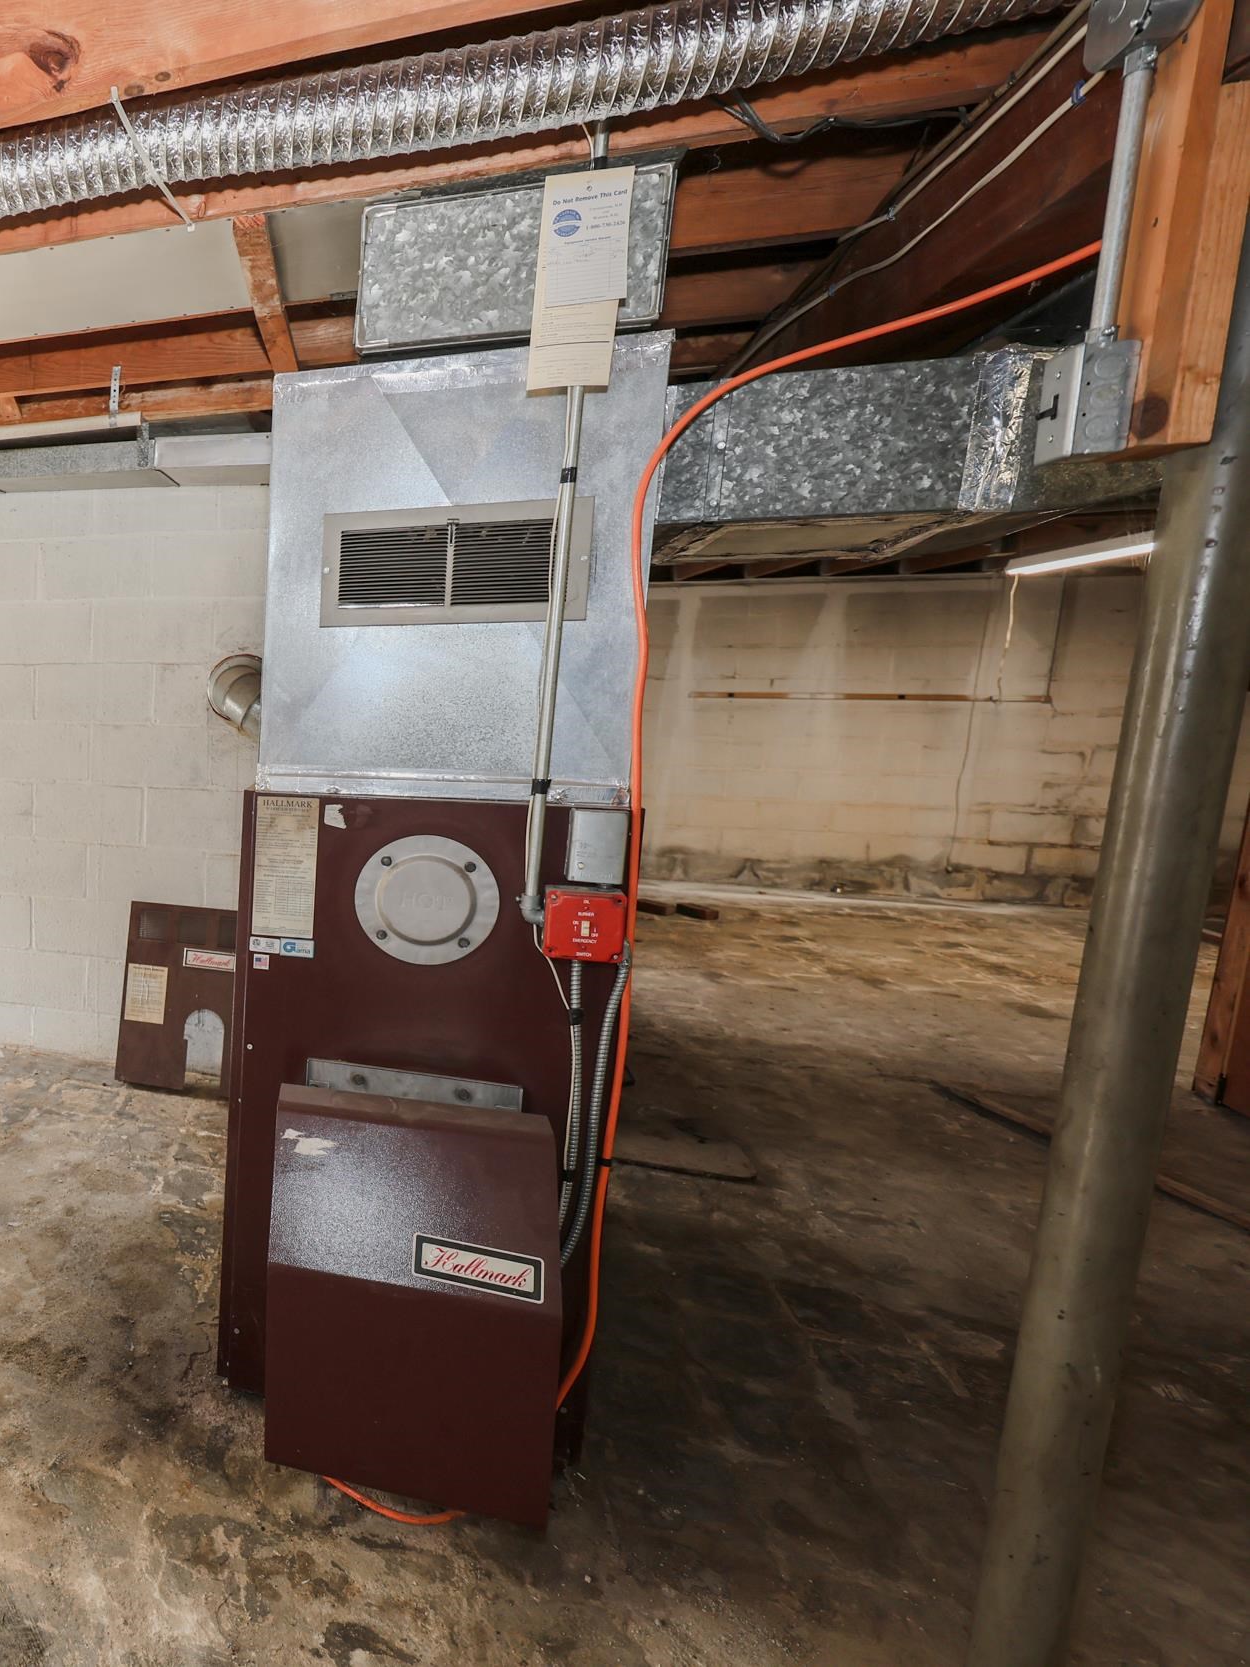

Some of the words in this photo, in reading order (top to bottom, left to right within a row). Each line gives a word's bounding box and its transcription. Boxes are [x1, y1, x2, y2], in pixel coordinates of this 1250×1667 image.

[263, 799, 312, 809] HALLMARK
[572, 937, 598, 945] EMERGENCY
[188, 953, 231, 968] Hallmark
[424, 1246, 532, 1289] Hallmark
